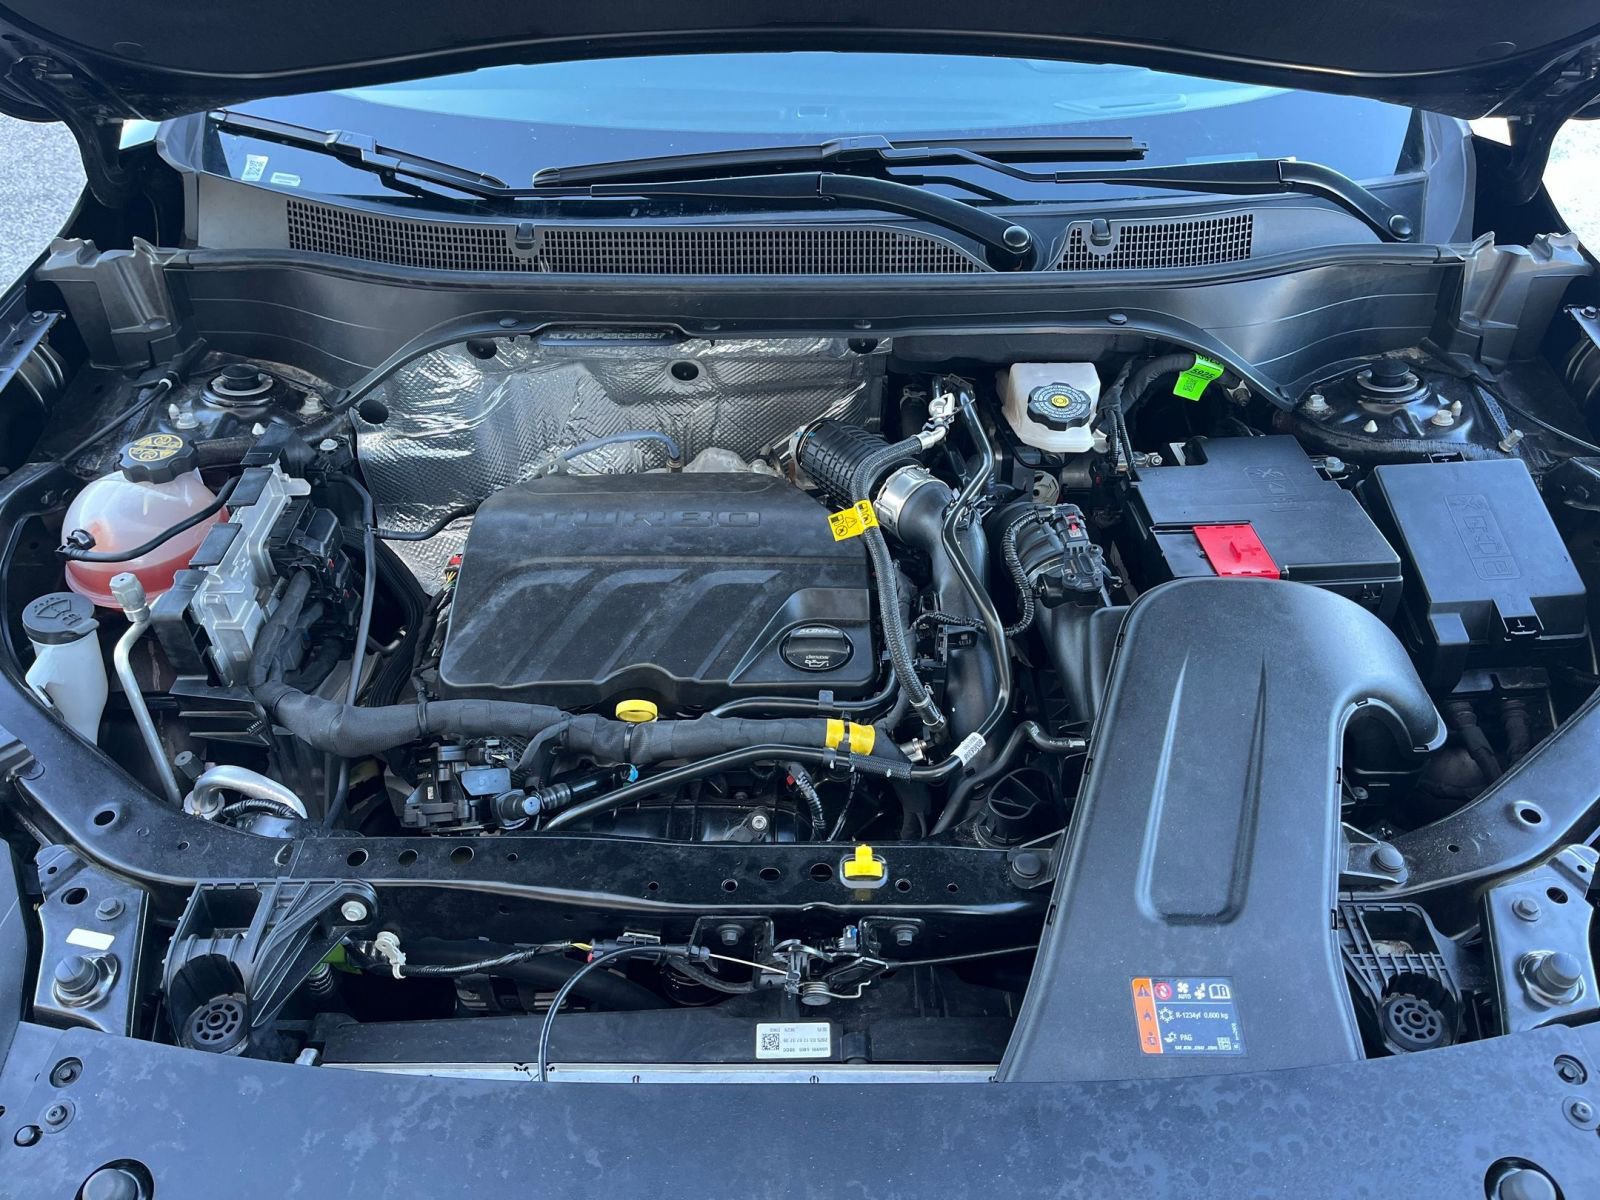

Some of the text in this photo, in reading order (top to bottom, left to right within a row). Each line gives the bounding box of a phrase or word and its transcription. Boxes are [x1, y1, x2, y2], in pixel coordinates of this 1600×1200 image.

[528, 510, 762, 528] TURBO
[1175, 1011, 1201, 1020] R-1234yf
[1220, 1011, 1229, 1020] kg
[1179, 1033, 1193, 1041] PAG
